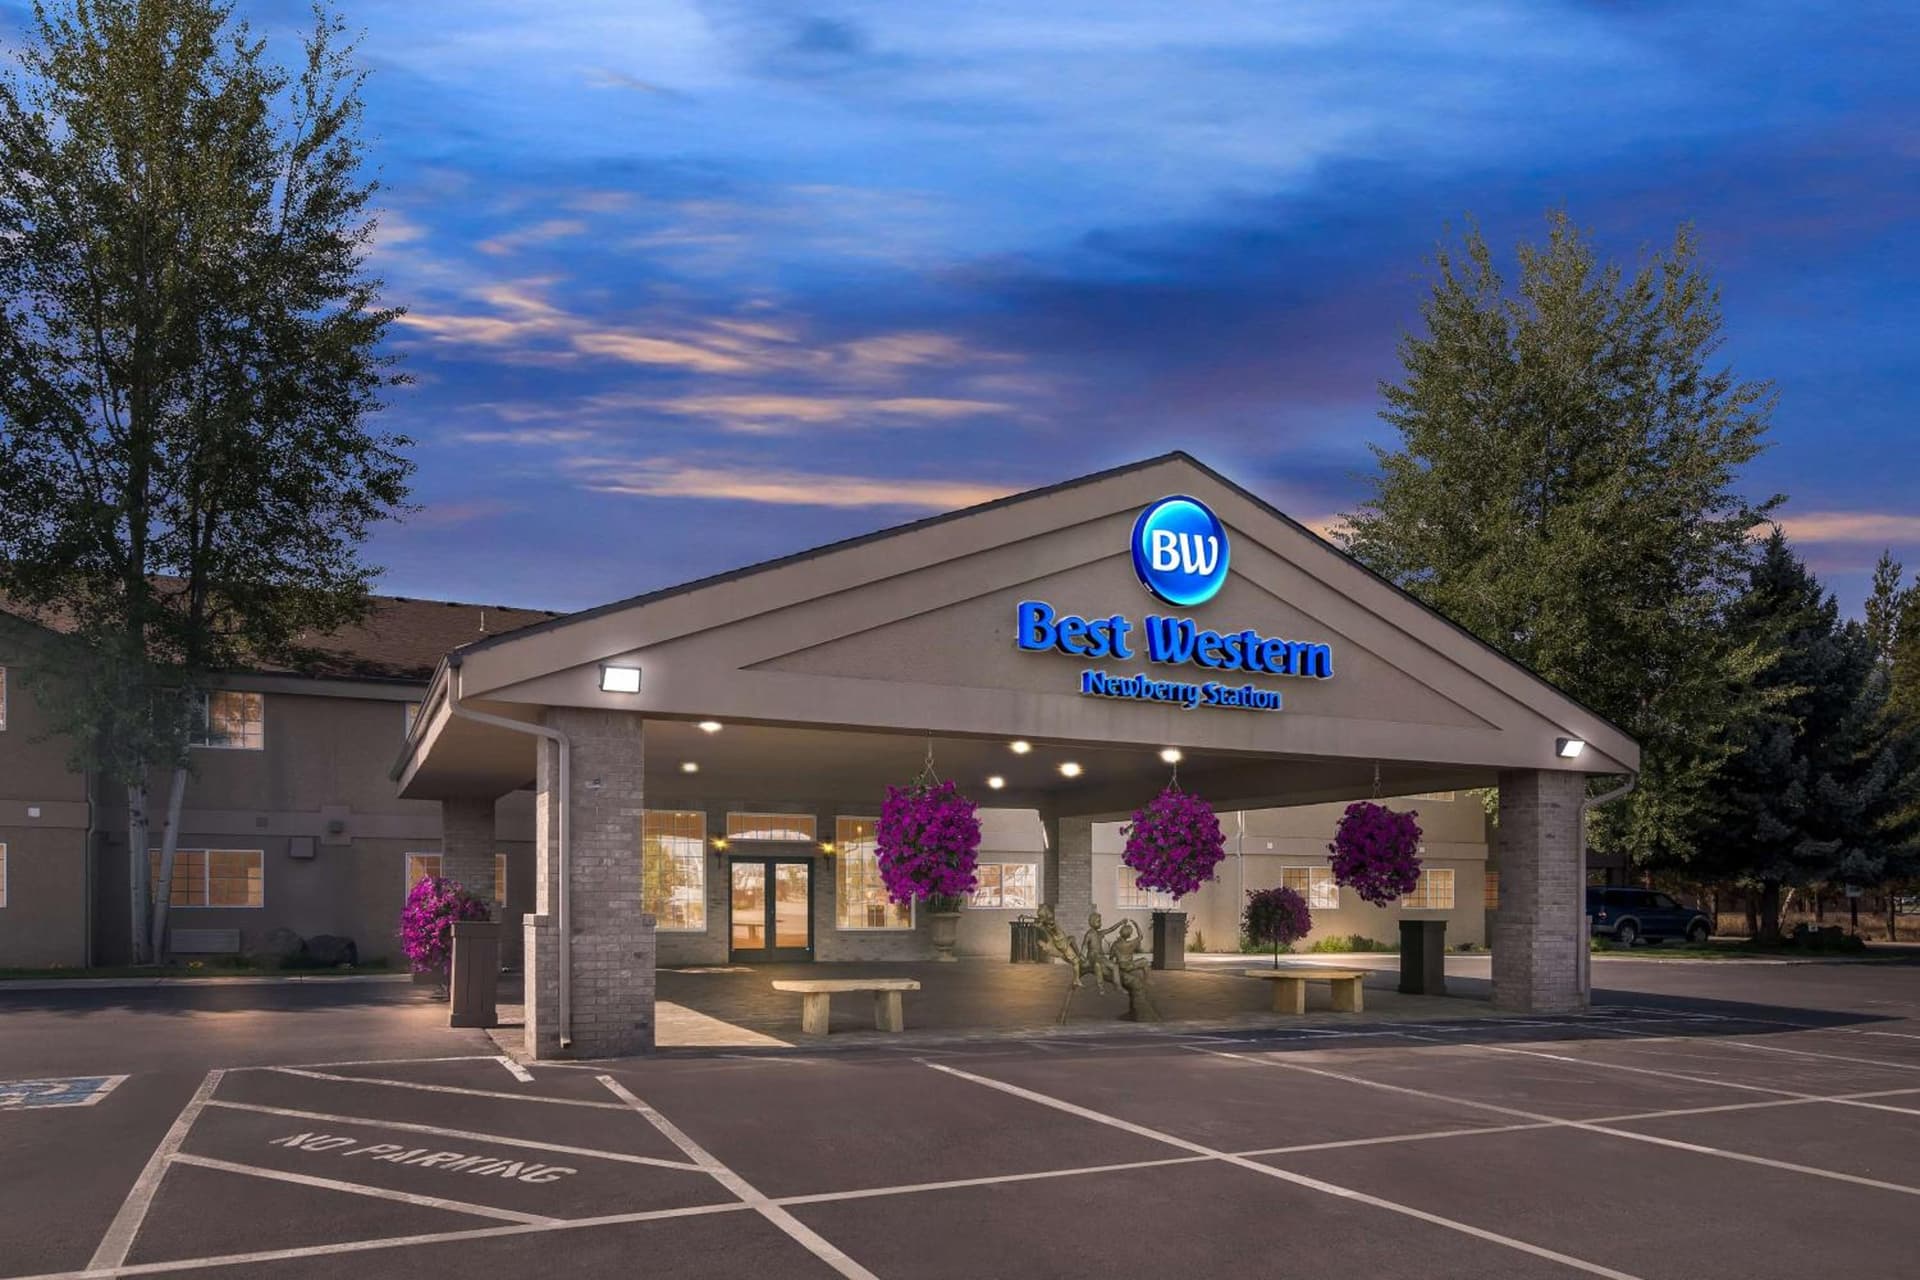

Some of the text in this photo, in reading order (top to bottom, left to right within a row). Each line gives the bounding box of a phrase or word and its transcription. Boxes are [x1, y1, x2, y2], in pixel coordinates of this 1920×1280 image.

[1152, 529, 1219, 576] BW
[1017, 601, 1334, 679] Best Western
[1081, 669, 1283, 711] Newberry Station
[269, 1132, 578, 1184] NO PARKING
